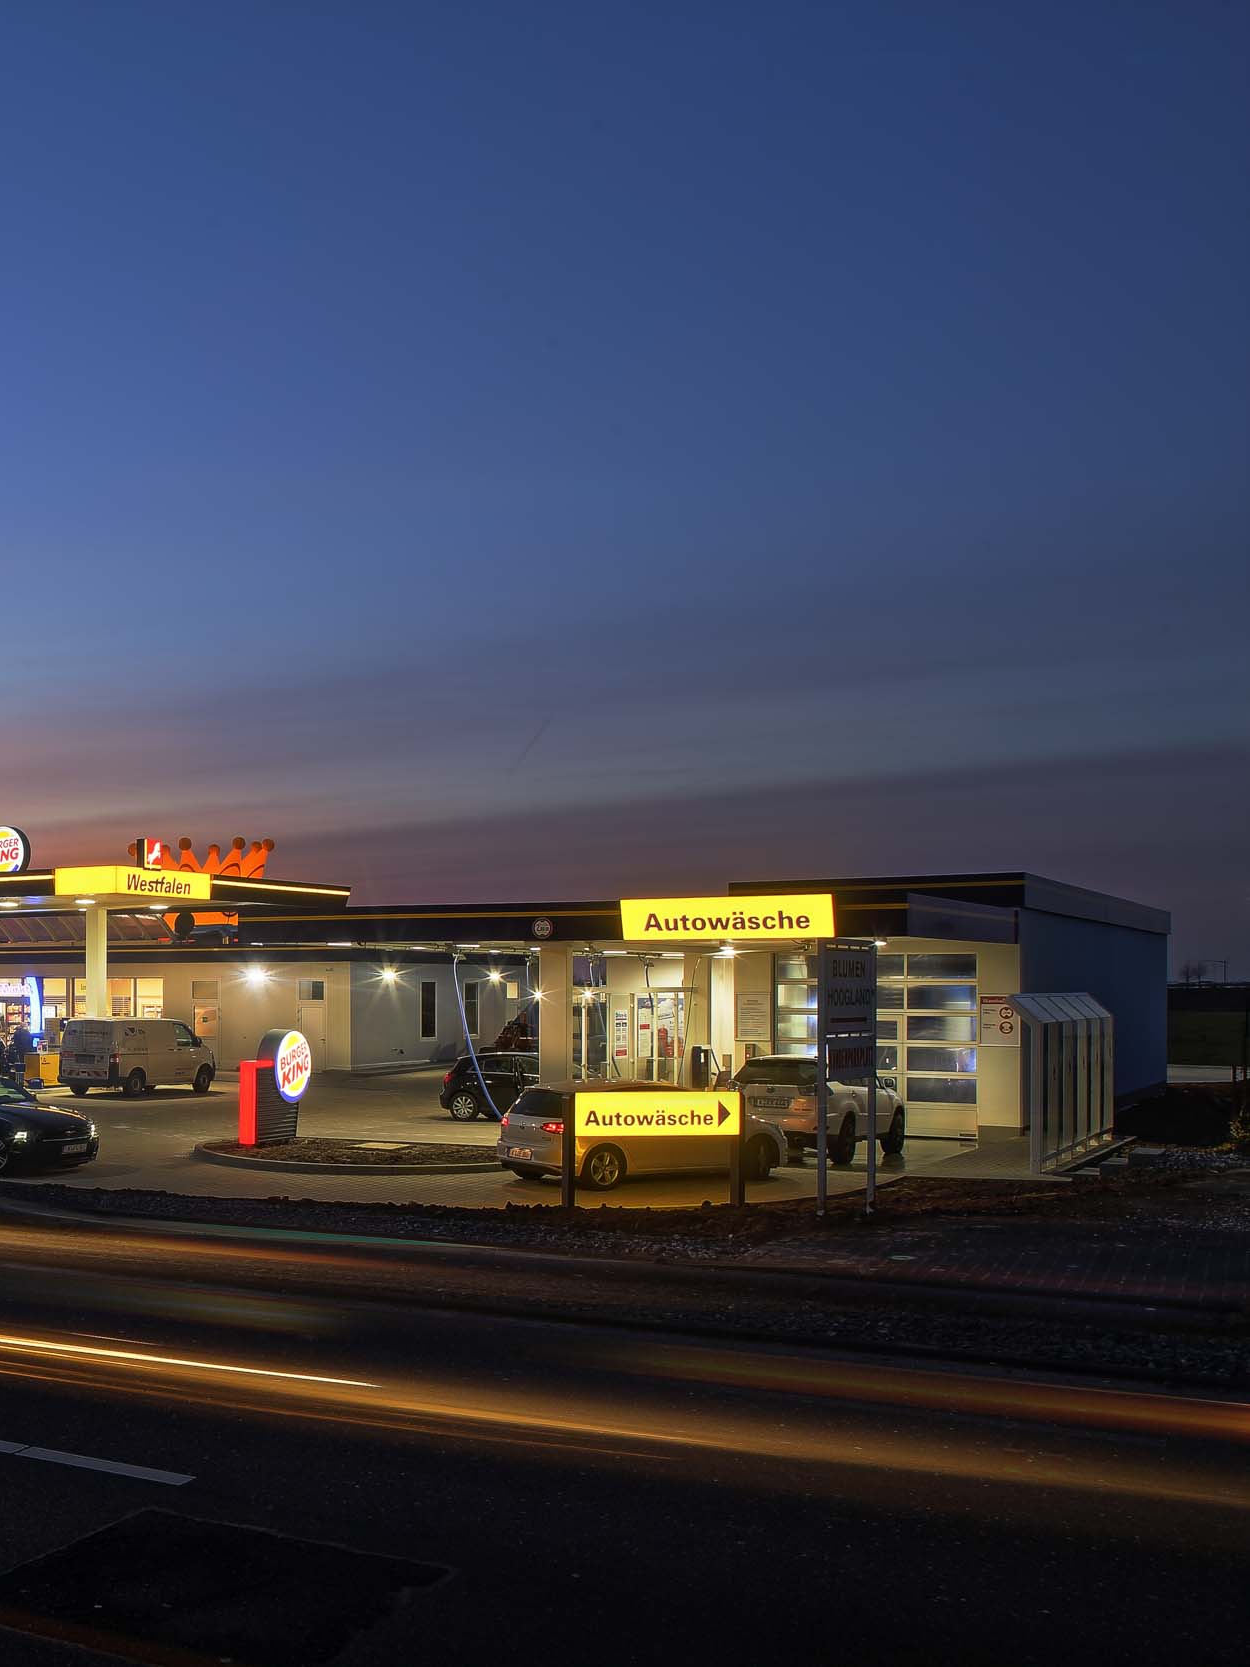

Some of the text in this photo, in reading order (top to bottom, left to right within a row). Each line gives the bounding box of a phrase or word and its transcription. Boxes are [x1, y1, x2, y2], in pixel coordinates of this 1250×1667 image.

[127, 874, 191, 895] Westfalen
[643, 910, 811, 931] Autowäsche
[832, 960, 866, 978] BLUMEN
[280, 1041, 307, 1070] BURGER
[281, 1054, 309, 1088] KING
[585, 1109, 714, 1127] Autowäsche
